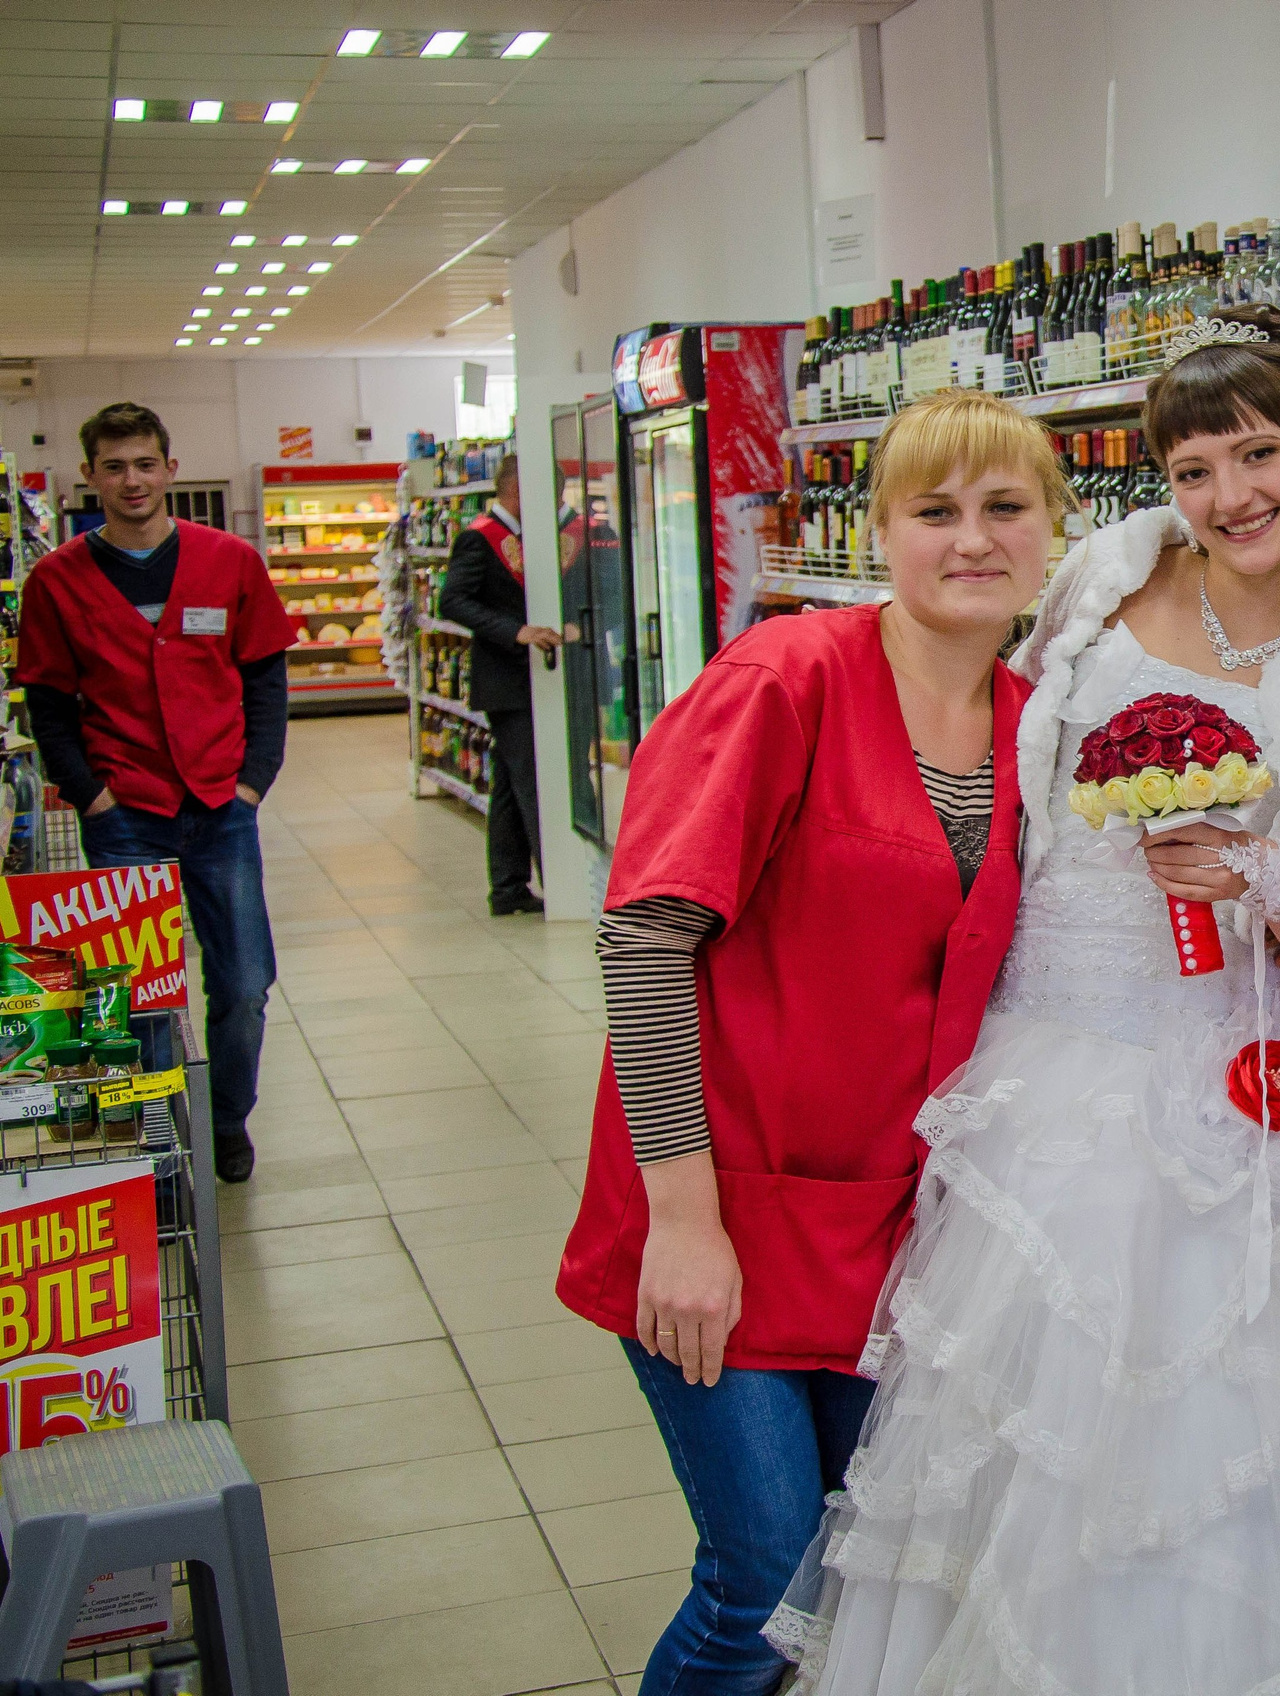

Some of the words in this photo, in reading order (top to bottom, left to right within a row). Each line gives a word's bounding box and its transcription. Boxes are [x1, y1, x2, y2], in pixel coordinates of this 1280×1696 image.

[31, 864, 174, 945] АКЦИЯ
[80, 905, 184, 978] ЦИЯ
[0, 998, 40, 1011] ACOBS
[137, 969, 187, 1006] АКЦИ
[0, 1198, 114, 1278] ДНЫЕ
[0, 1254, 130, 1360] ВЛЕ!
